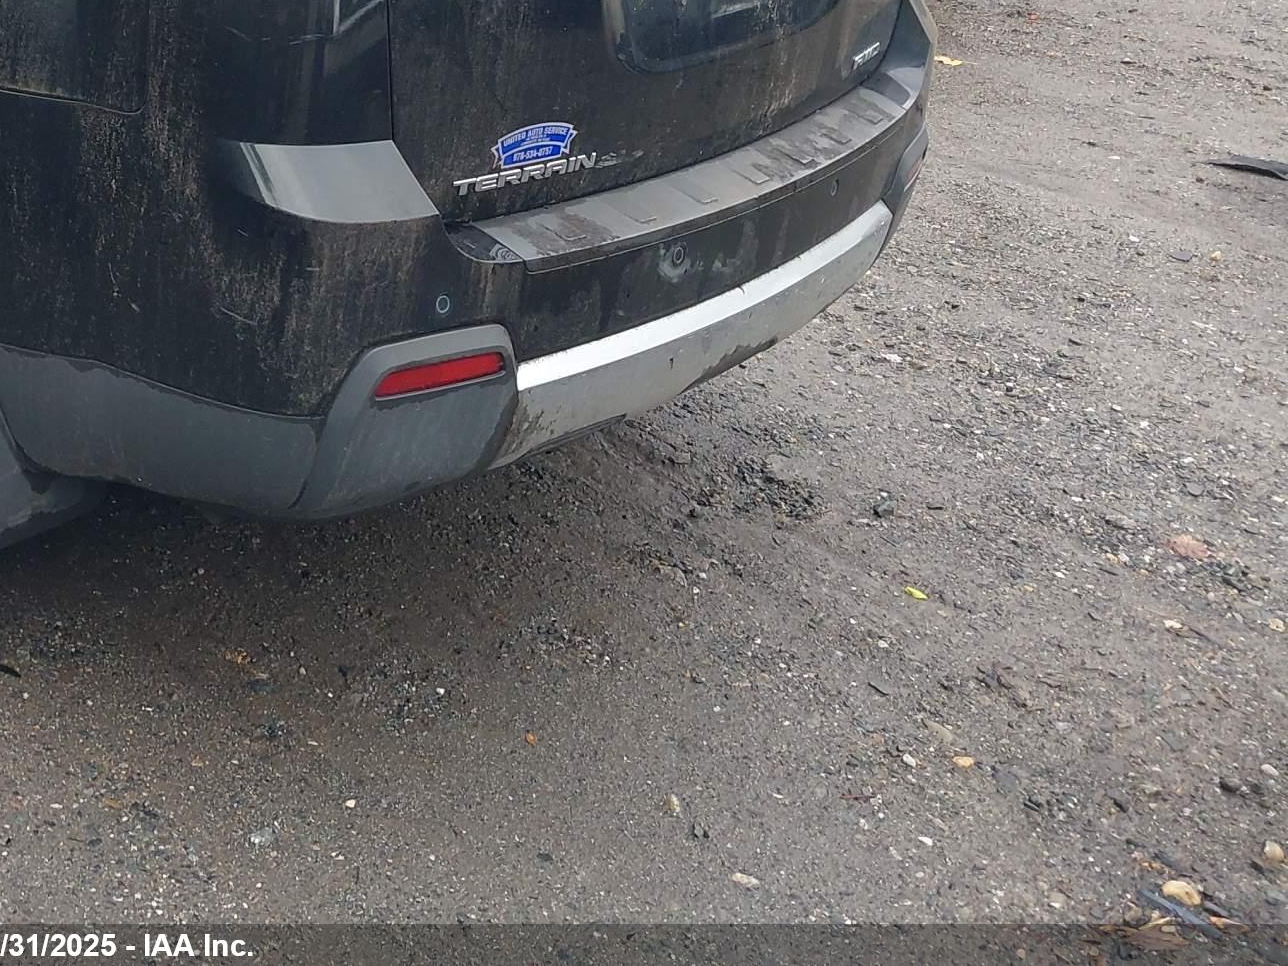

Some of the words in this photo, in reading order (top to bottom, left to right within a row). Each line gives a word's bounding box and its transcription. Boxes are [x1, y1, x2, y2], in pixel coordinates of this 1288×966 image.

[503, 131, 527, 147] UNITED
[527, 127, 544, 138] AUTO
[544, 126, 569, 136] SERVICE
[453, 152, 597, 196] TERRAIN
